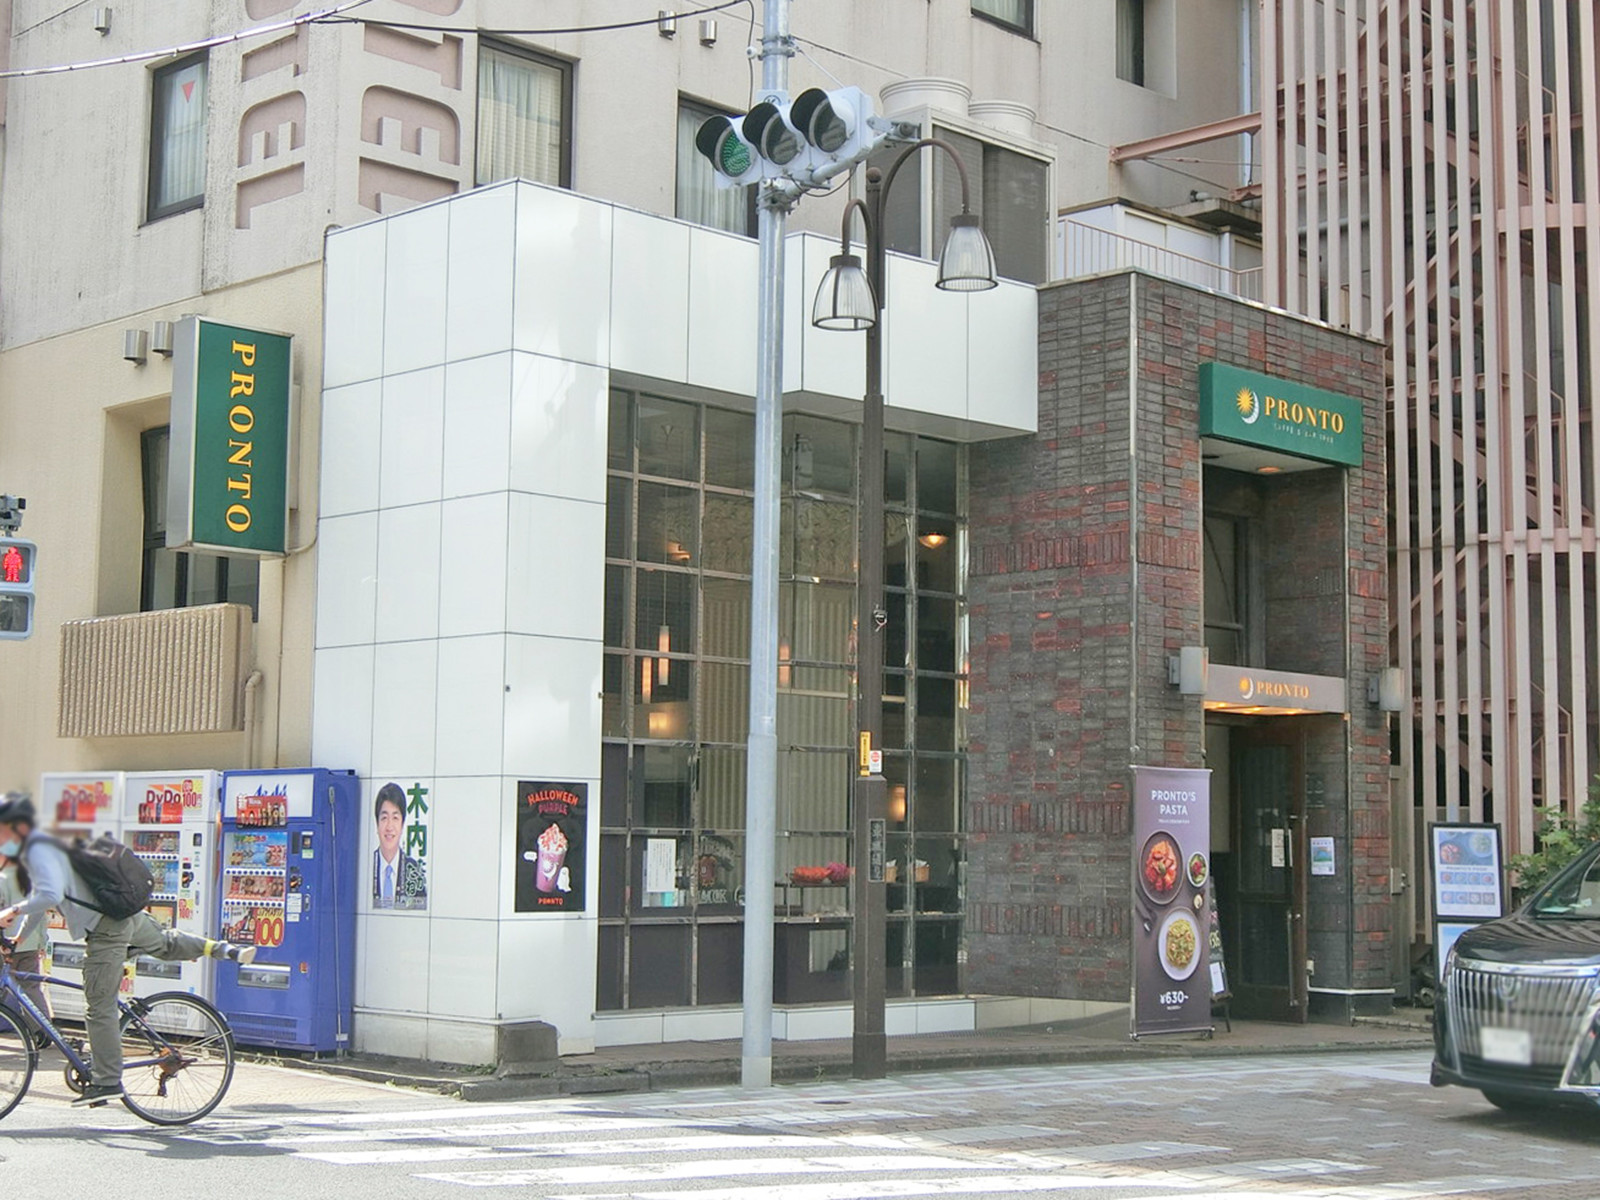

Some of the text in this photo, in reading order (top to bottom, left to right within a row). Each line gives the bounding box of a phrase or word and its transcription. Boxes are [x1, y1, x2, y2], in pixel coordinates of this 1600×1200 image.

[1264, 396, 1345, 434] PRONTO
[224, 339, 257, 533] PRONTO
[1256, 680, 1310, 699] PRONTO
[146, 789, 182, 806] DyDo
[527, 789, 579, 806] HALLOWEEN
[1151, 790, 1197, 802] PRONTO'S
[406, 782, 429, 857] 木内
[1159, 804, 1188, 816] PASTA
[255, 917, 284, 946] 100
